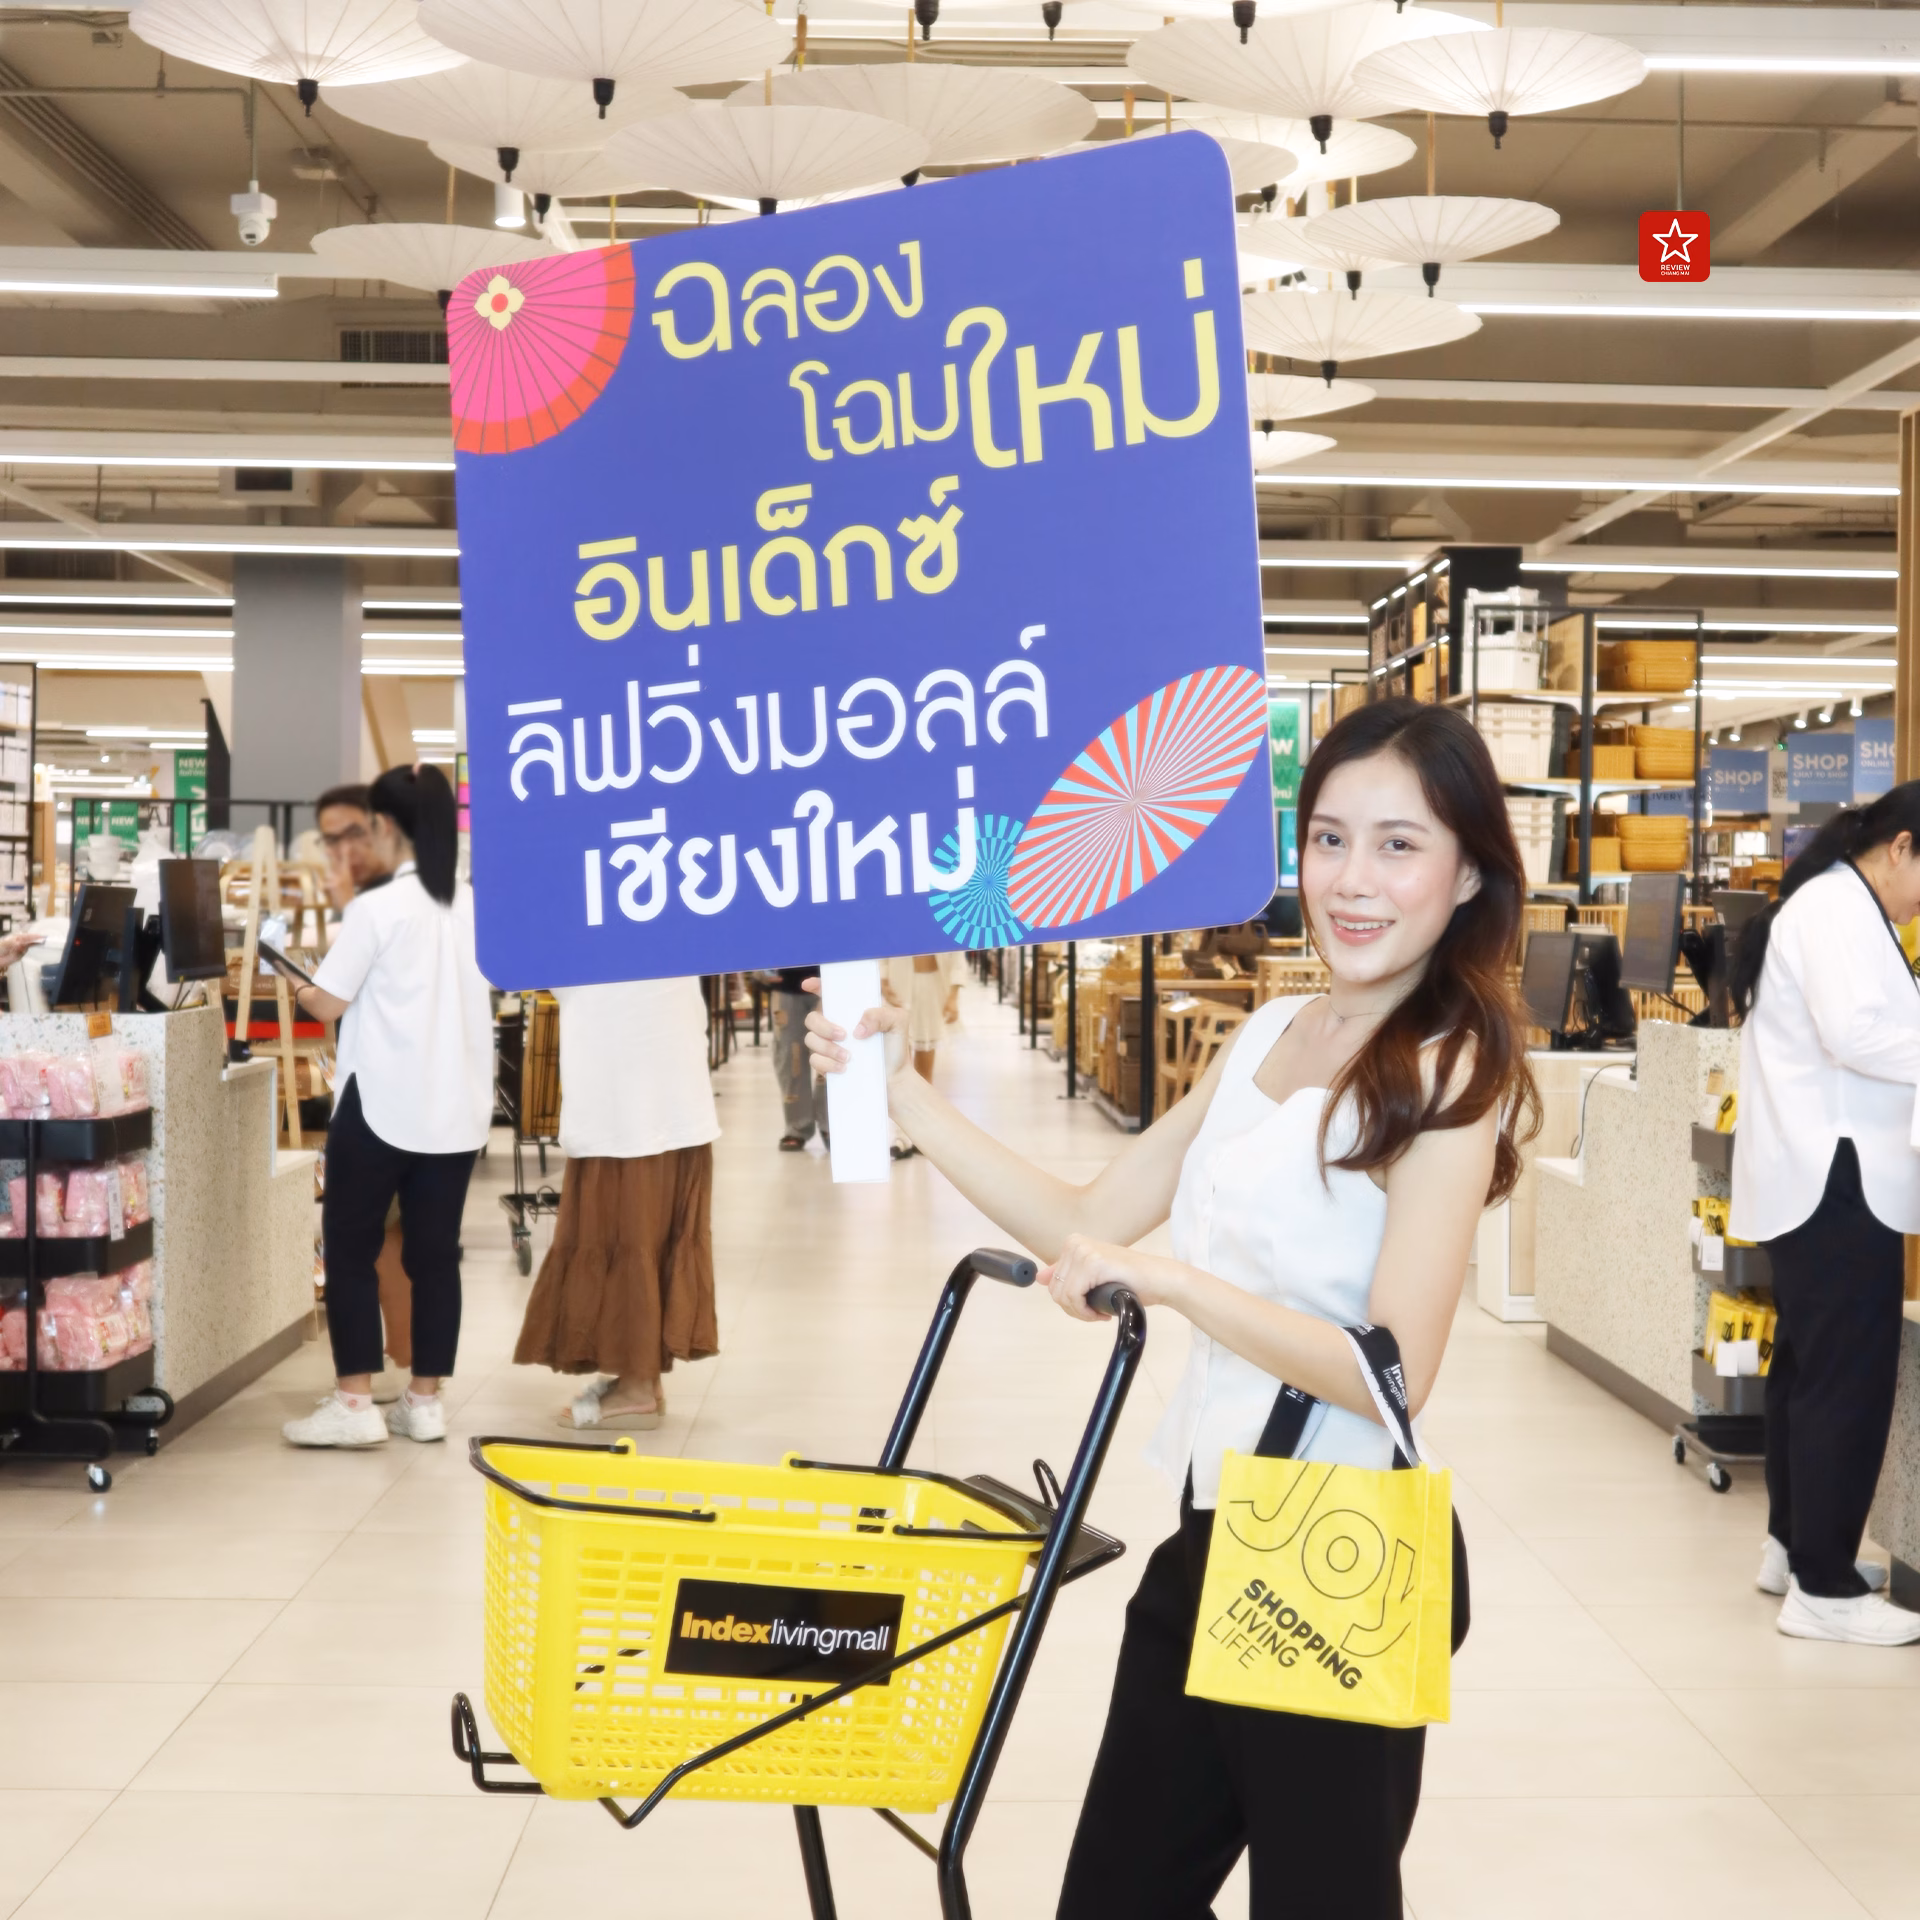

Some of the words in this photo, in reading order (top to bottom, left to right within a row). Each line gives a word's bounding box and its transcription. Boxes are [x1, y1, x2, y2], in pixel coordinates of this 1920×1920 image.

[651, 240, 925, 360] ฉลอง
[789, 258, 1220, 470] โฉมใหม่
[574, 475, 964, 641] อินเด็กซ์
[507, 624, 1050, 802] ลิฟวิ่งมอลล์
[1793, 753, 1849, 770] SHOP
[111, 816, 135, 827] NEW
[1714, 769, 1763, 785] SHOP
[584, 766, 977, 926] เชียงใหม่
[1207, 1615, 1263, 1670] LIFE
[1226, 1596, 1300, 1668] LIVING
[1243, 1578, 1363, 1690] SHOPPING
